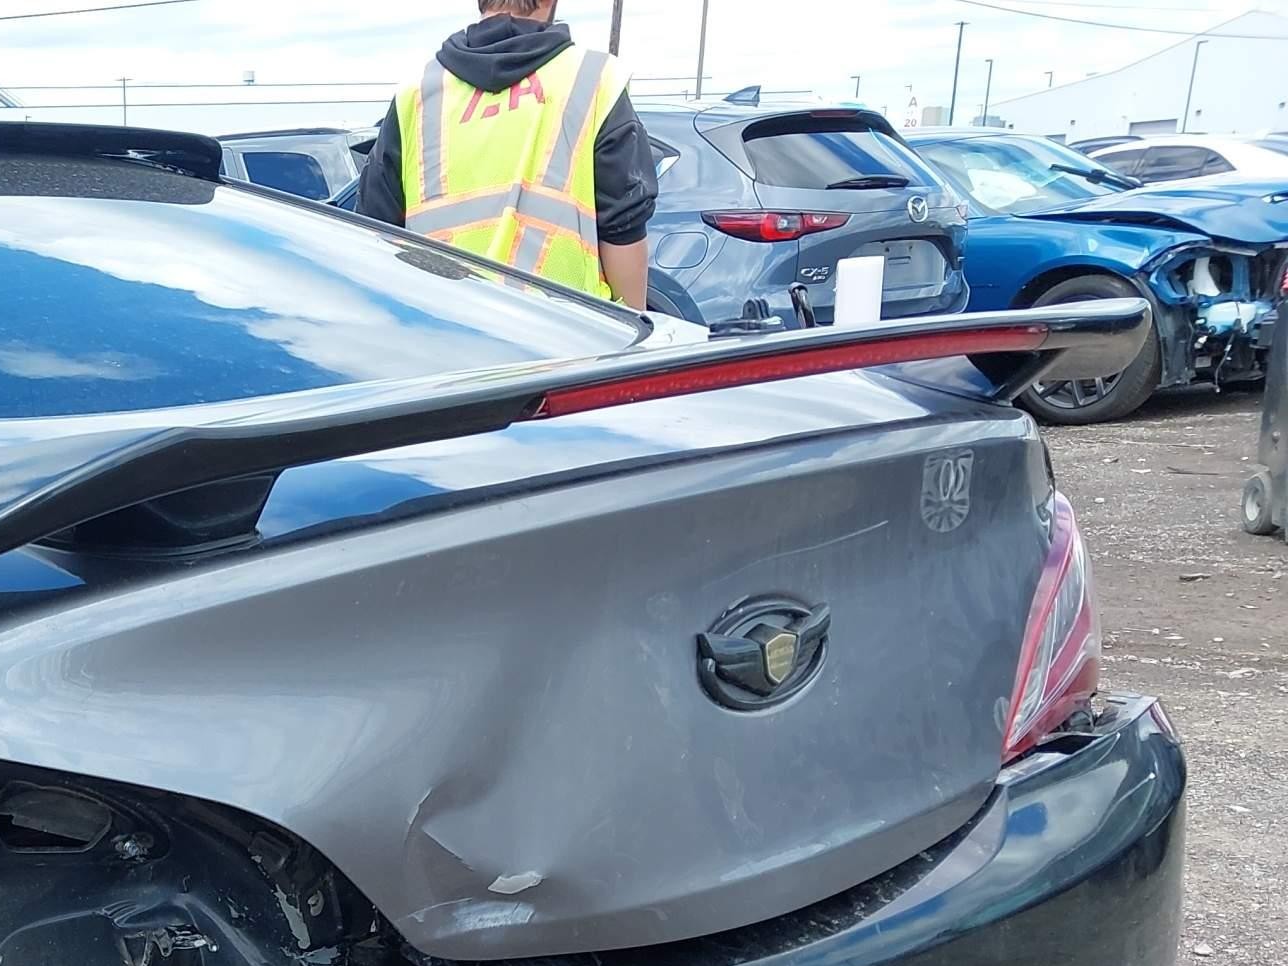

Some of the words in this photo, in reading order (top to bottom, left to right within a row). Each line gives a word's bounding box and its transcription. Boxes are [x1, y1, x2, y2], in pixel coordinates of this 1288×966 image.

[908, 96, 918, 108] A
[903, 118, 917, 128] 20
[800, 266, 830, 277] CX-5
